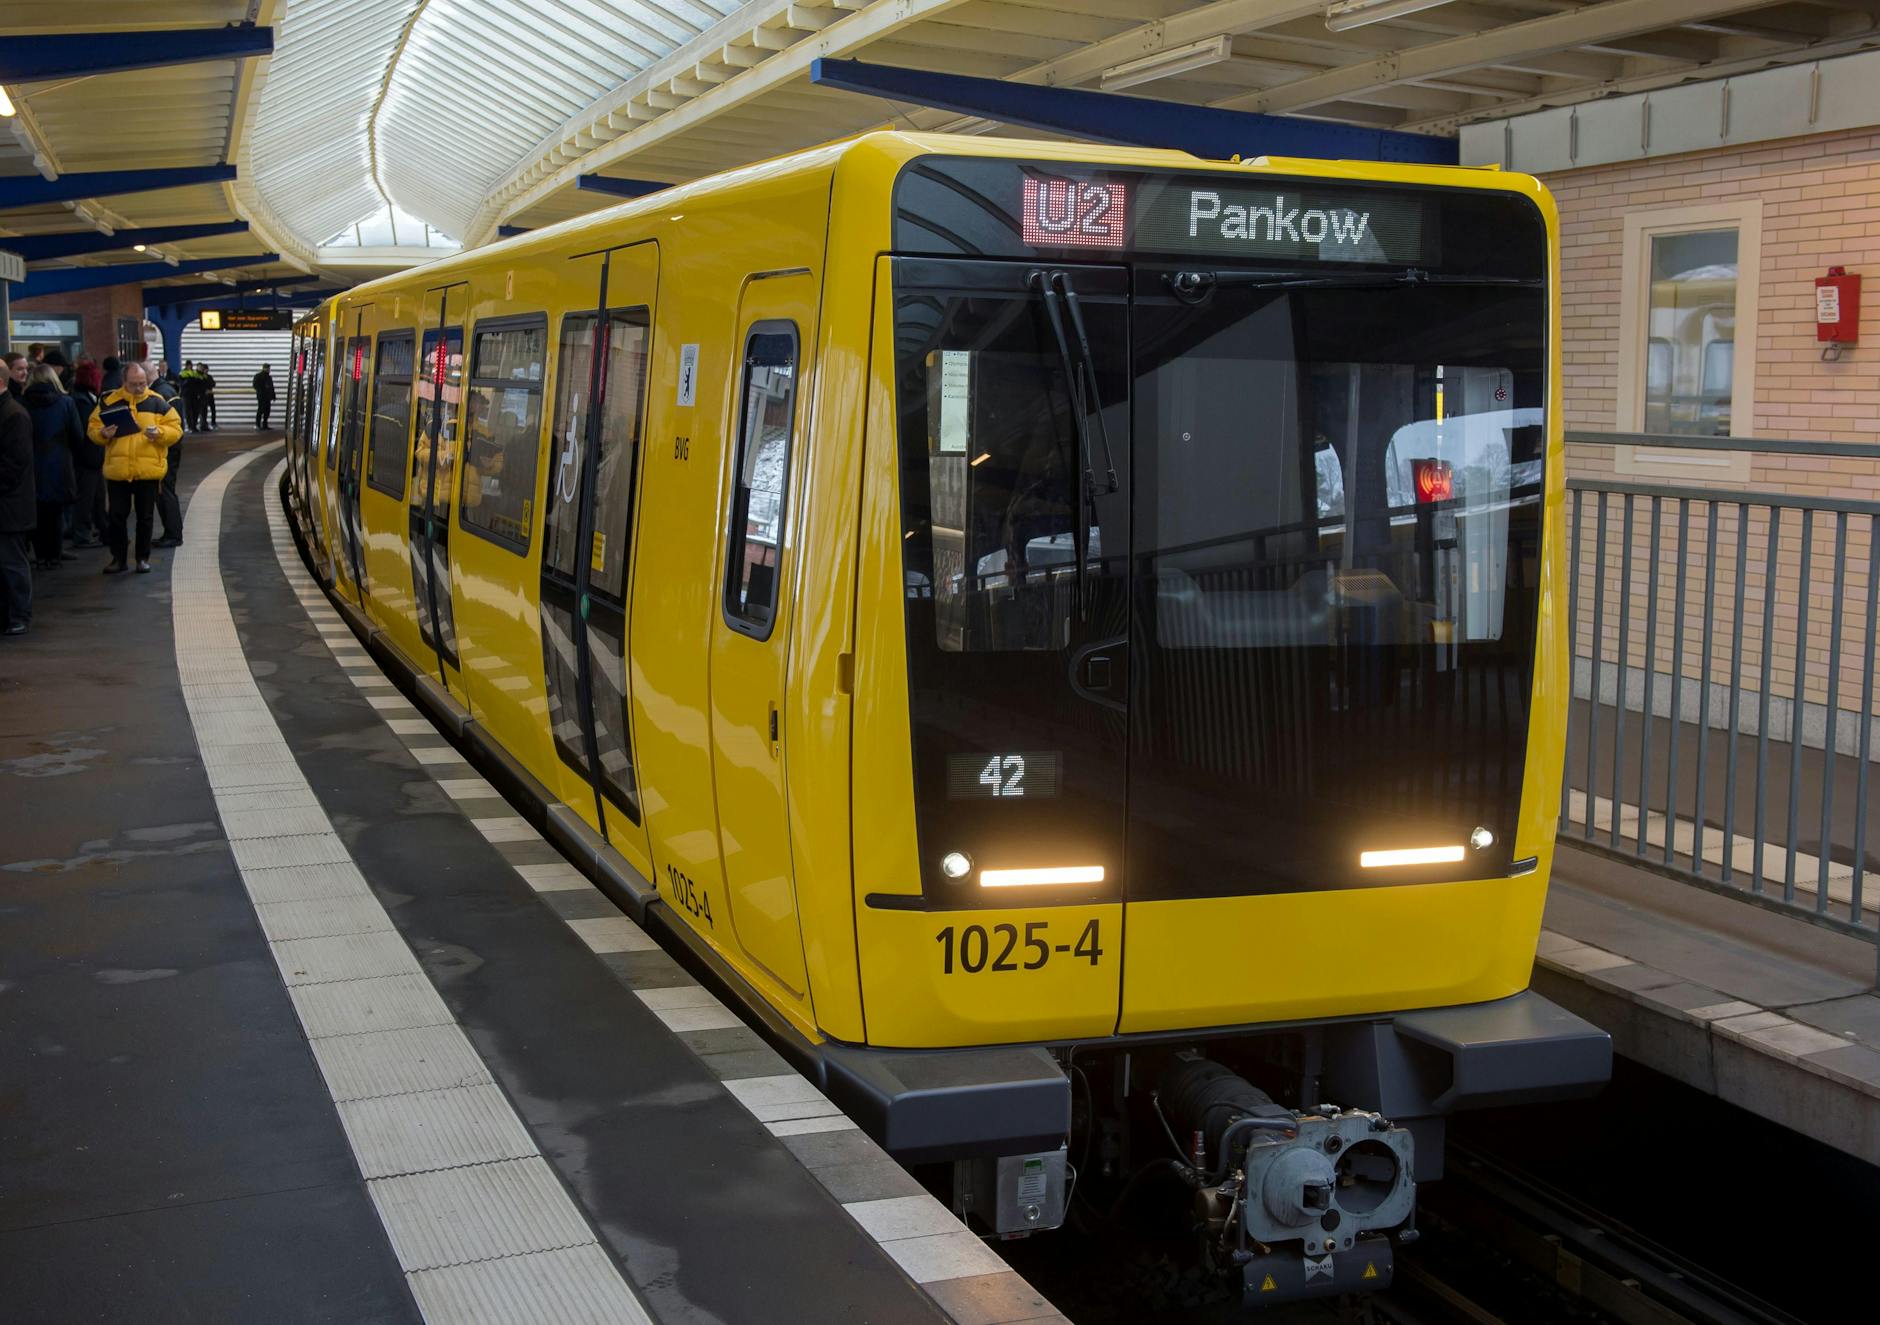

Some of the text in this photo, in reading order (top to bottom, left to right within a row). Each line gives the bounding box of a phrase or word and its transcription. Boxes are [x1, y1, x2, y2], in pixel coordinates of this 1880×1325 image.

[1039, 183, 1370, 244] U2 Pankow
[674, 436, 689, 461] BVG
[979, 755, 1025, 796] 42
[667, 863, 714, 930] 1025-4
[935, 918, 1104, 975] 1025-4
[1306, 1263, 1332, 1272] SCHAKU
